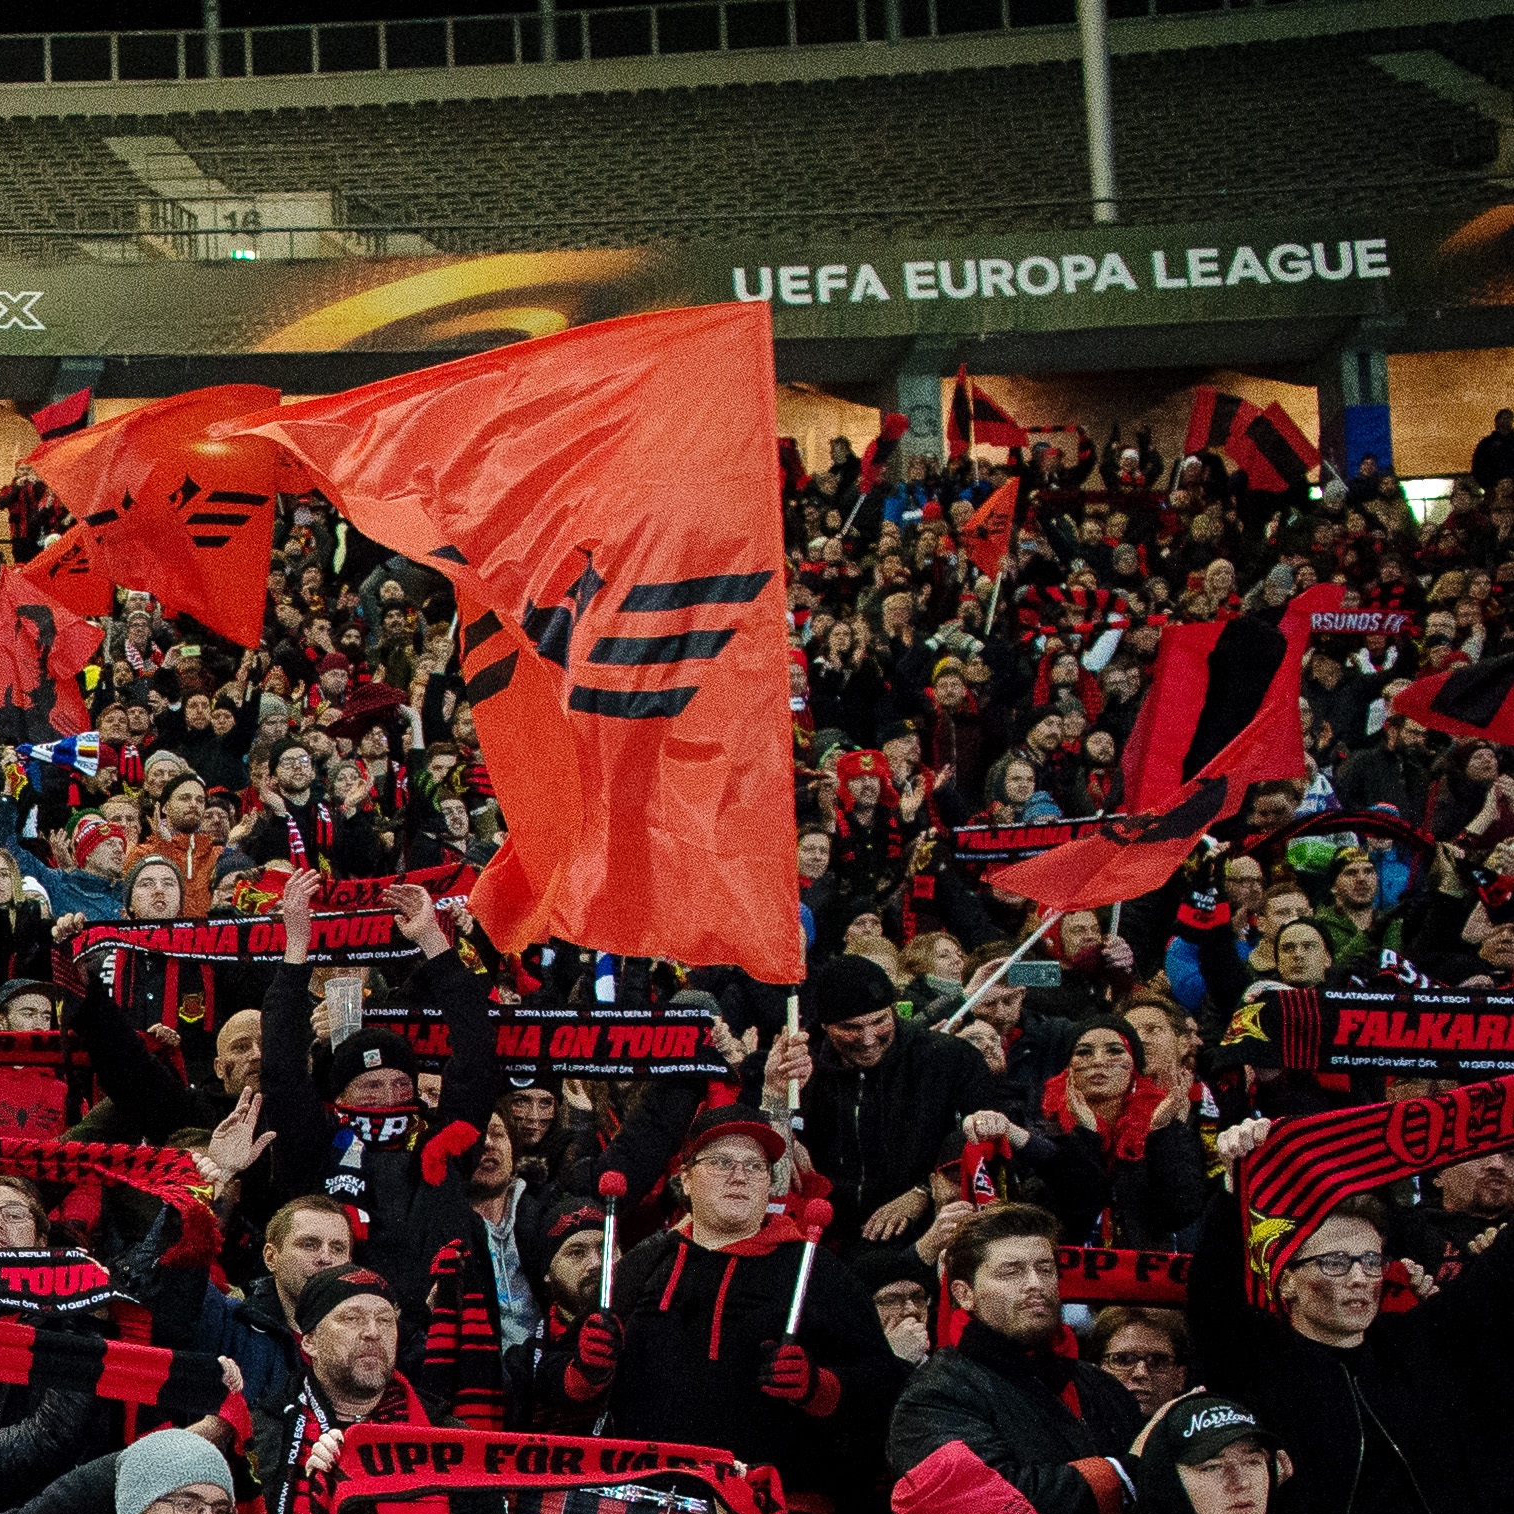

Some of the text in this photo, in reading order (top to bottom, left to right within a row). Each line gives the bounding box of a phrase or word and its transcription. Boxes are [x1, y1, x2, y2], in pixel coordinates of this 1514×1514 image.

[732, 239, 1392, 305] UEFA EUROPA LEAGUE
[1325, 991, 1397, 1002] GALATASARAY
[549, 1024, 701, 1059] ON TOUR
[1333, 1009, 1514, 1050] FALKAR
[0, 1263, 110, 1297] TOUR
[1182, 1409, 1257, 1438] Norrland
[356, 1440, 465, 1478] UPP
[484, 1434, 585, 1476] FÖR
